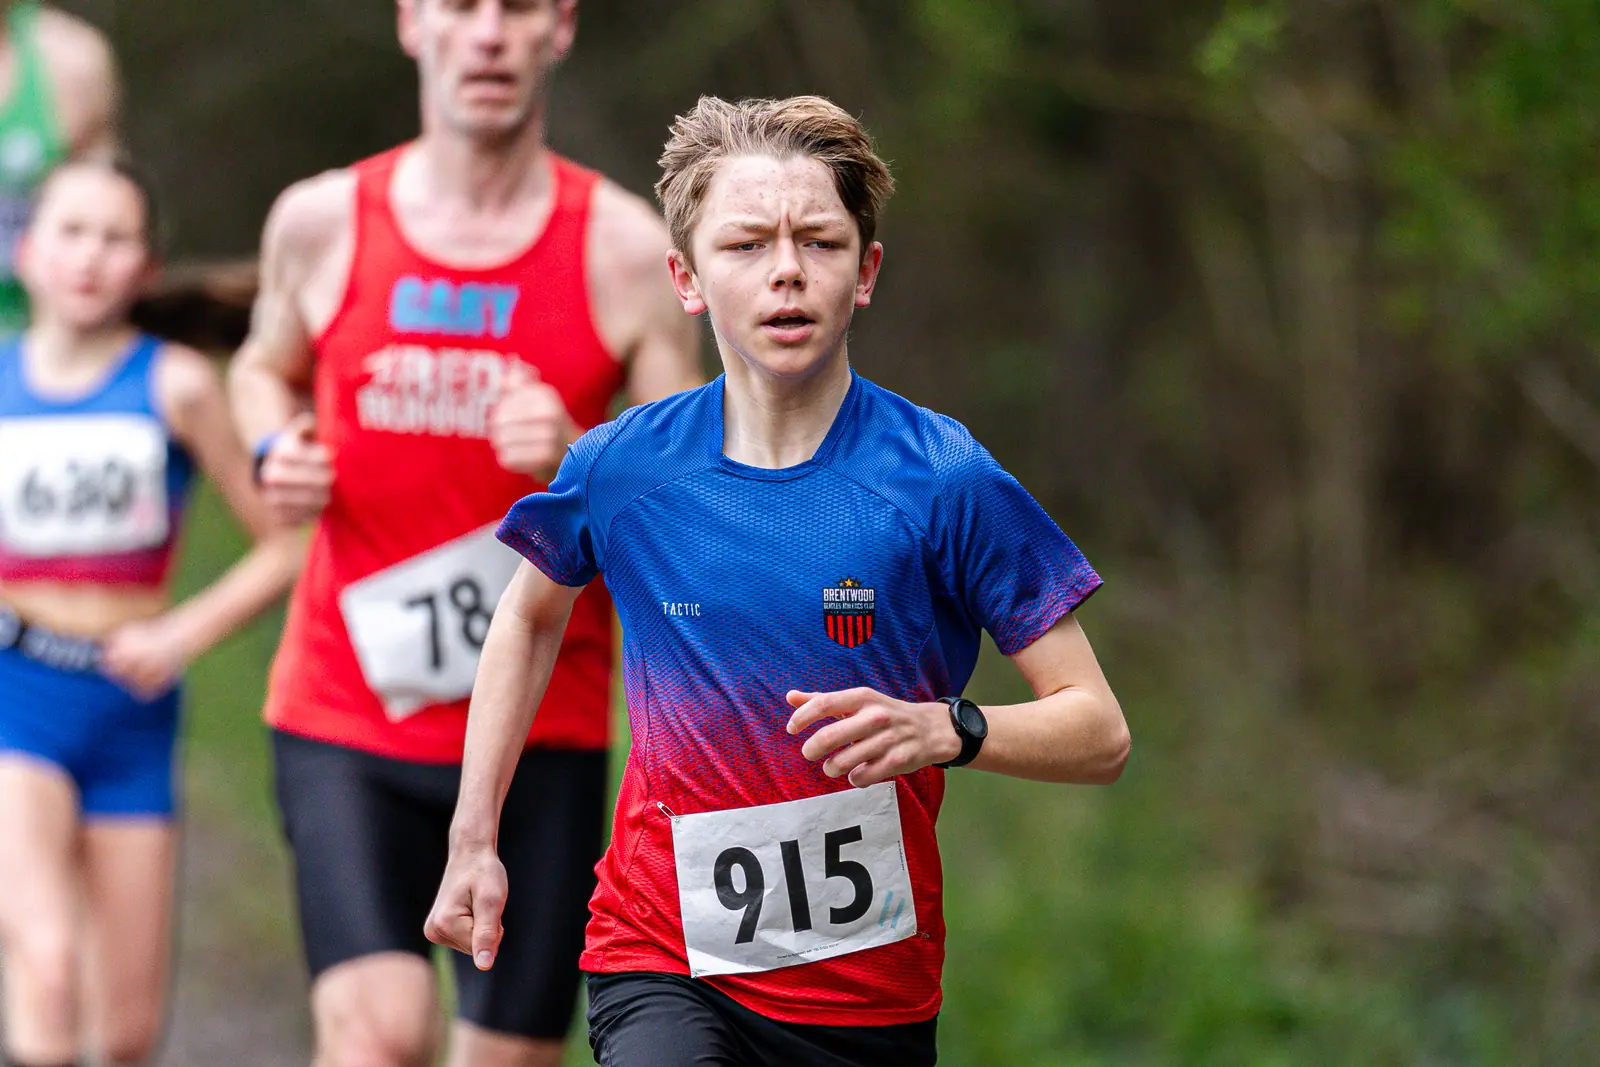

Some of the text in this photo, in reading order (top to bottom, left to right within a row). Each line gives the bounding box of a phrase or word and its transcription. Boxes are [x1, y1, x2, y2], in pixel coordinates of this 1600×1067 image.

[823, 587, 875, 602] BRENTWOOD
[662, 601, 700, 617] TACTIC
[713, 824, 874, 945] 915
